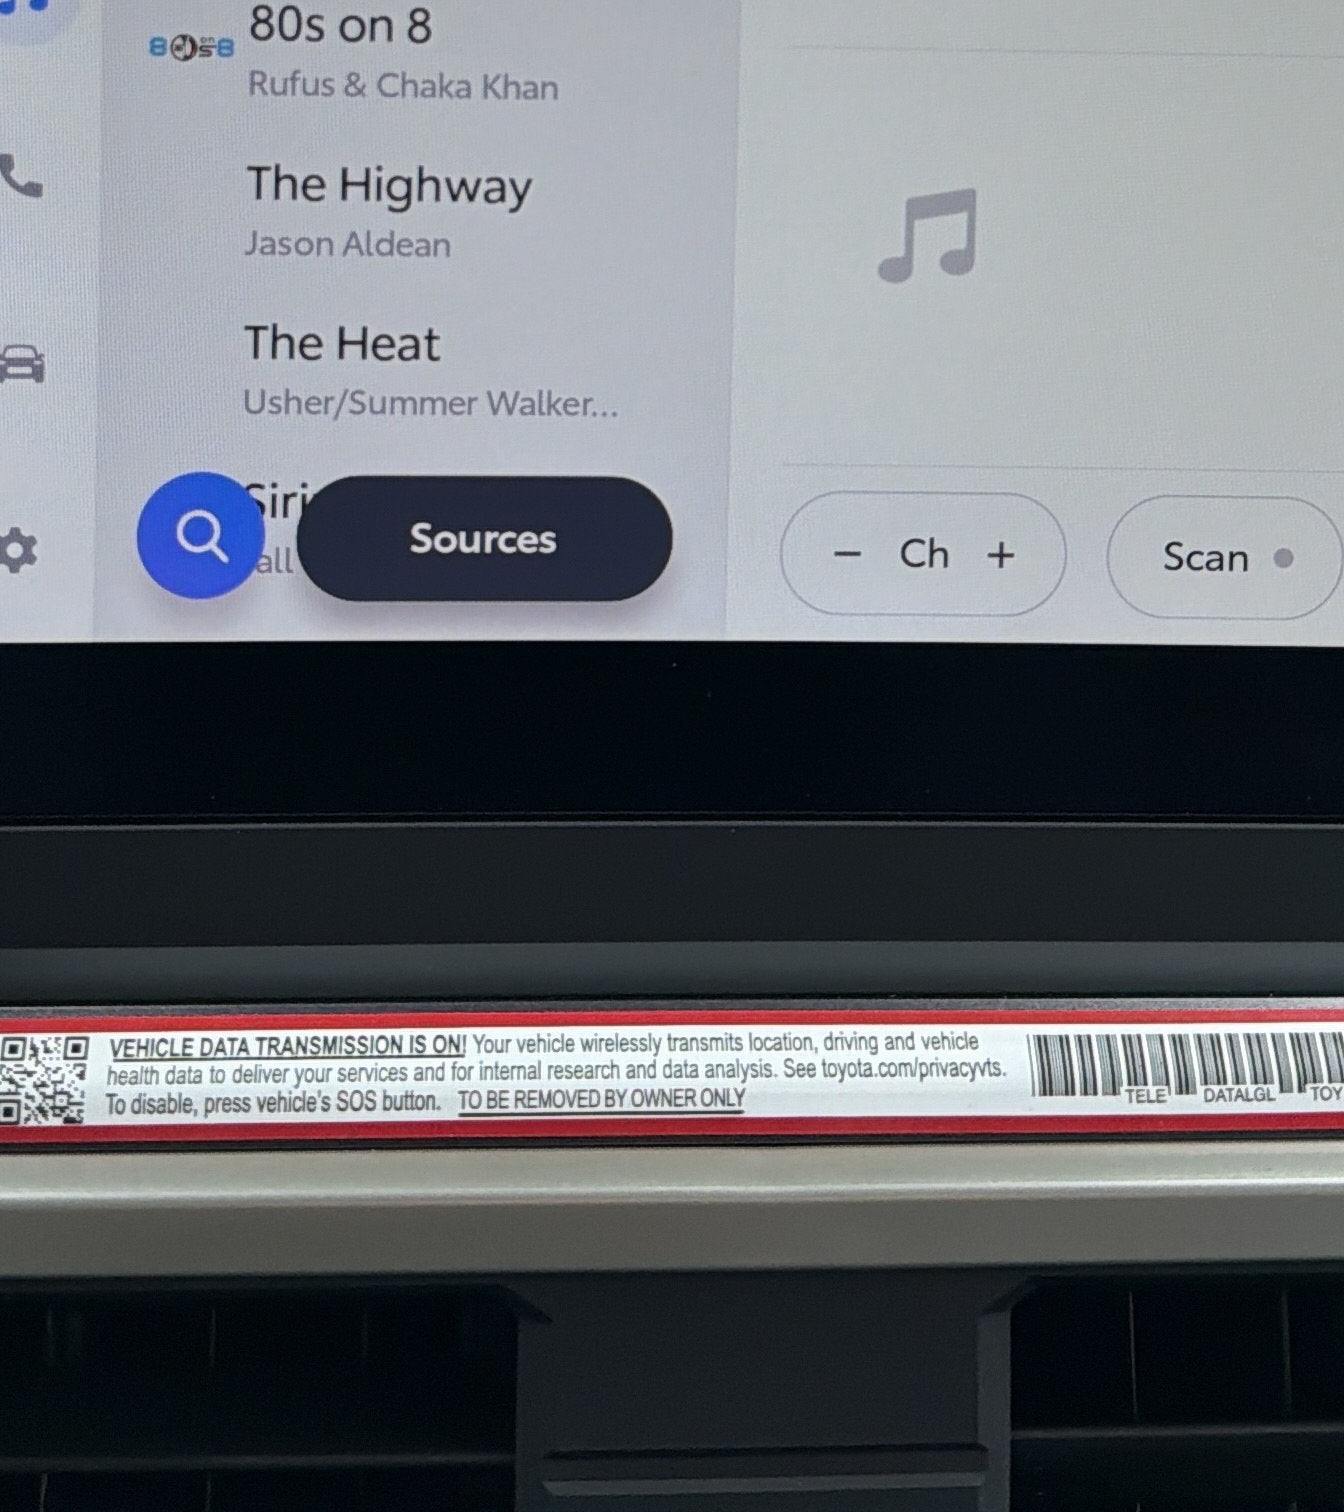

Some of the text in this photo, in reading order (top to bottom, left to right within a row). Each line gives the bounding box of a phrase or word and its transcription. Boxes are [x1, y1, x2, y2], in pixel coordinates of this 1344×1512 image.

[250, 4, 432, 44] 80s on 8
[249, 70, 559, 102] Rufus & Chaka Khan
[247, 165, 533, 212] The Highway
[244, 231, 451, 258] Jason Aldean
[245, 325, 441, 362] The Heat
[244, 389, 618, 420] Usher/Summer Walker...
[411, 523, 557, 555] Sources
[900, 538, 949, 569] Ch
[1164, 542, 1248, 572] Scan
[110, 1030, 979, 1058] VEHICLE DATA TRANSMISSION IS ON! Your vehicle wirelessly transmits location, driving and vehicle
[107, 1056, 1007, 1089] health data to deliver your services and for internal research and data analysis. See toyota.com/privacyvts.
[106, 1087, 746, 1119] To disable, press vehicle's SOS button. TO BE REMOVED BY OWNER ONLY
[1125, 1086, 1344, 1104] TELE DATALGL TOY
